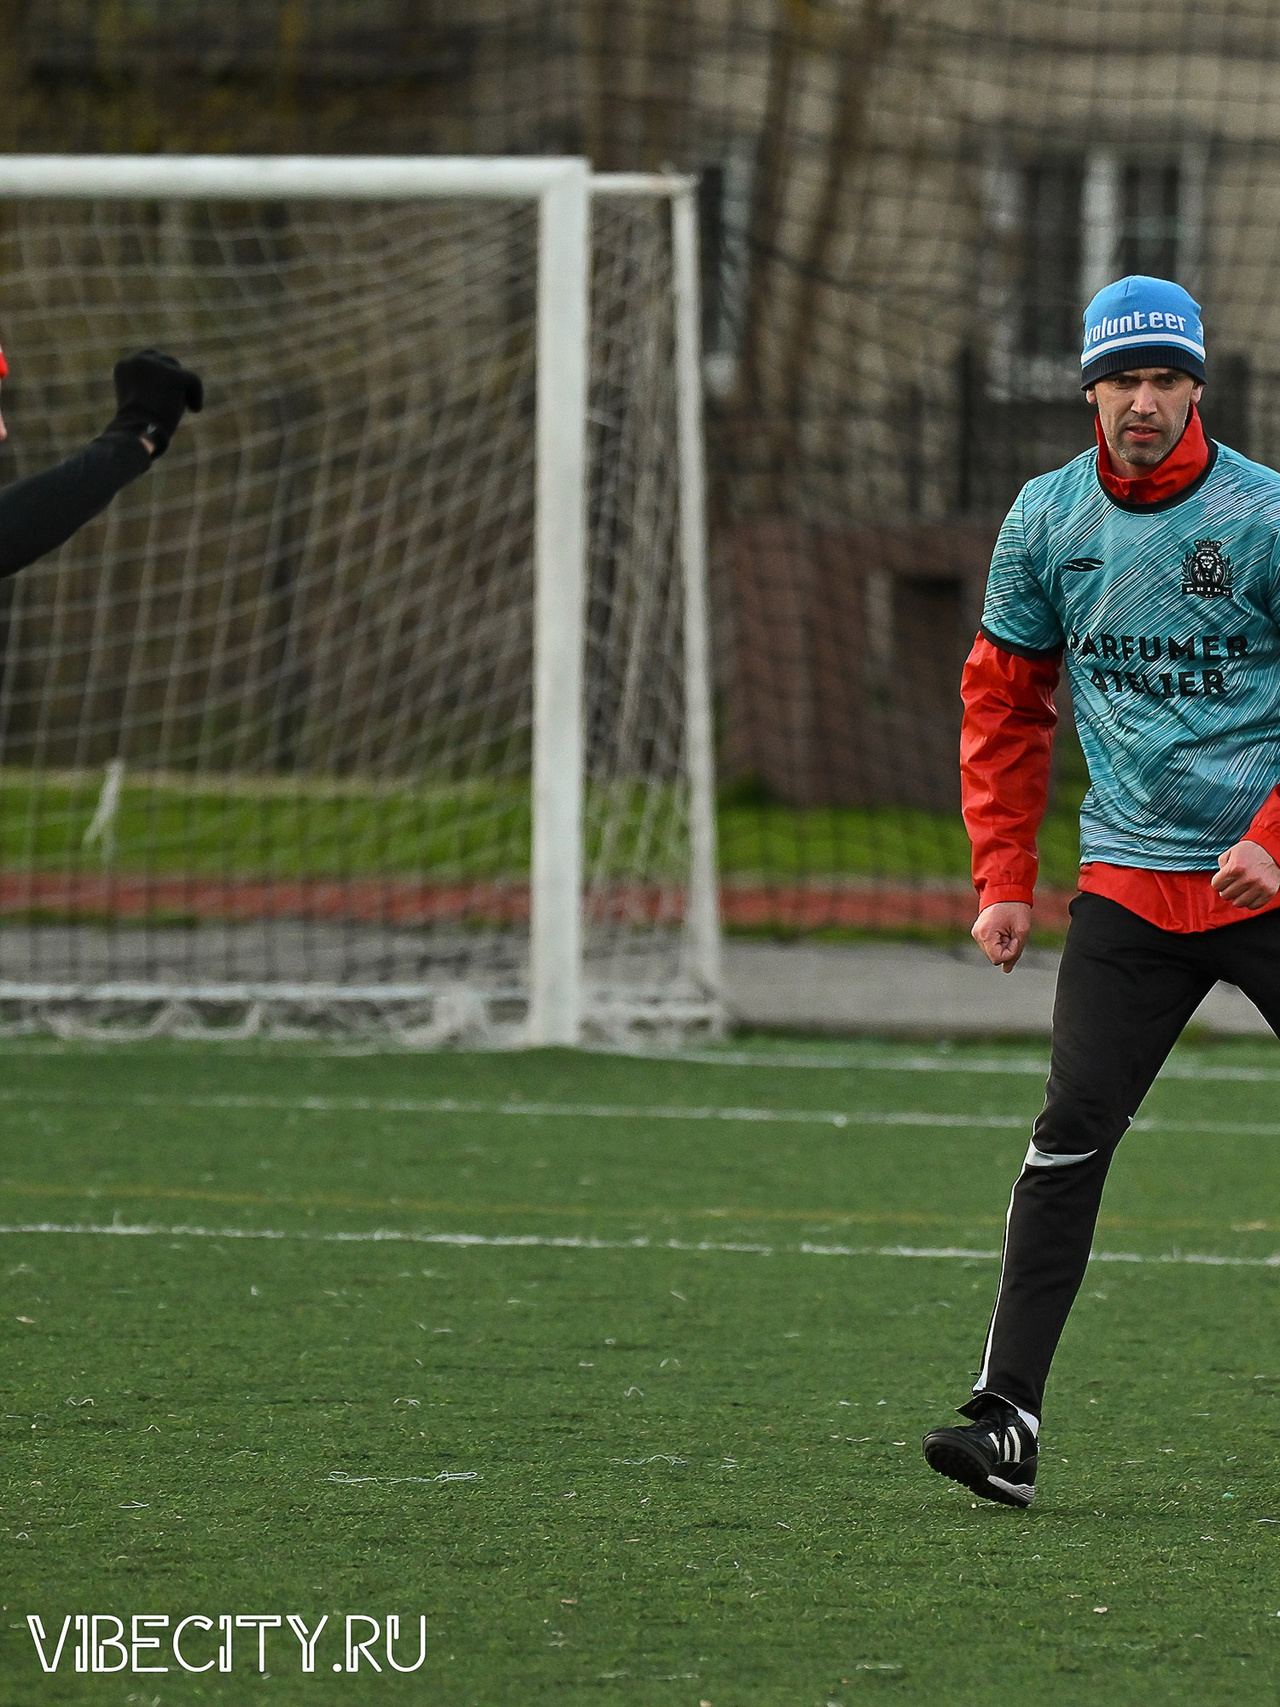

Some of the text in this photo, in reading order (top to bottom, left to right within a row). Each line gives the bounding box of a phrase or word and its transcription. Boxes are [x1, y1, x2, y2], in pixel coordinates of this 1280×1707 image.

[1085, 311, 1187, 346] volunteer
[1069, 629, 1249, 662] PARFUMER
[1090, 668, 1227, 699] ATELIER
